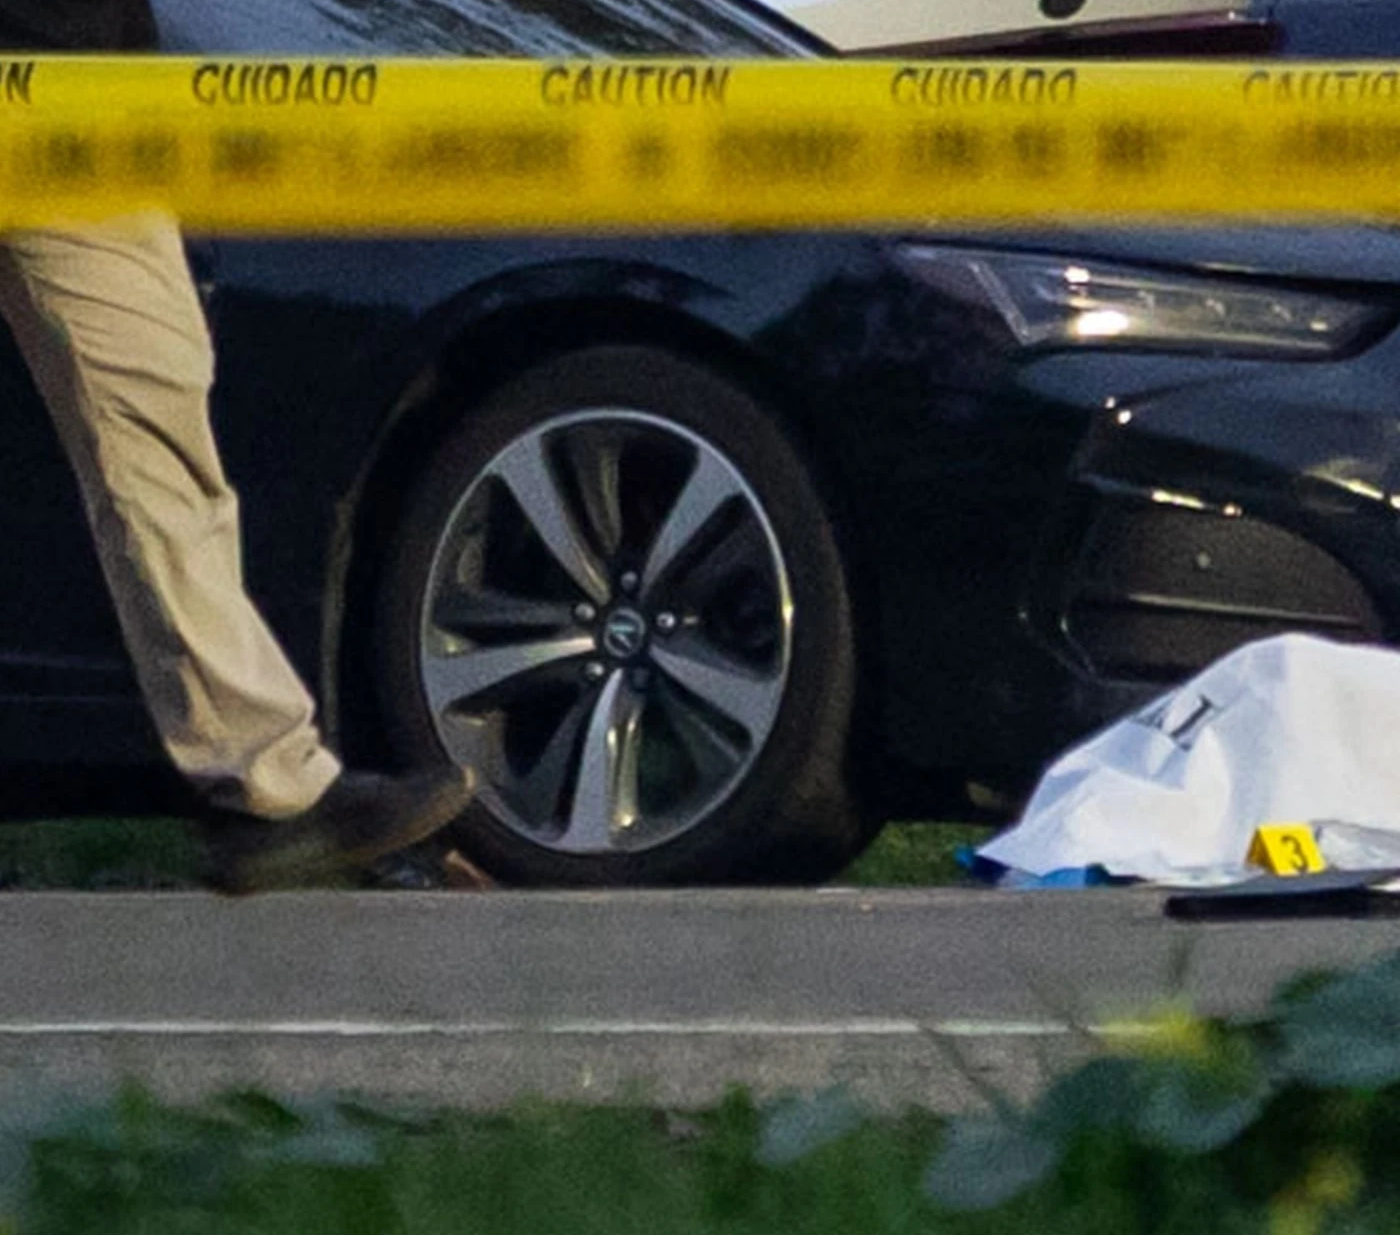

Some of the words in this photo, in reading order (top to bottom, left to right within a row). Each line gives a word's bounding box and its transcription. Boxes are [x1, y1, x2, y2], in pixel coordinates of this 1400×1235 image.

[192, 63, 377, 106] CUIDADO
[541, 65, 730, 107] CAUTION
[1281, 833, 1309, 873] 3
